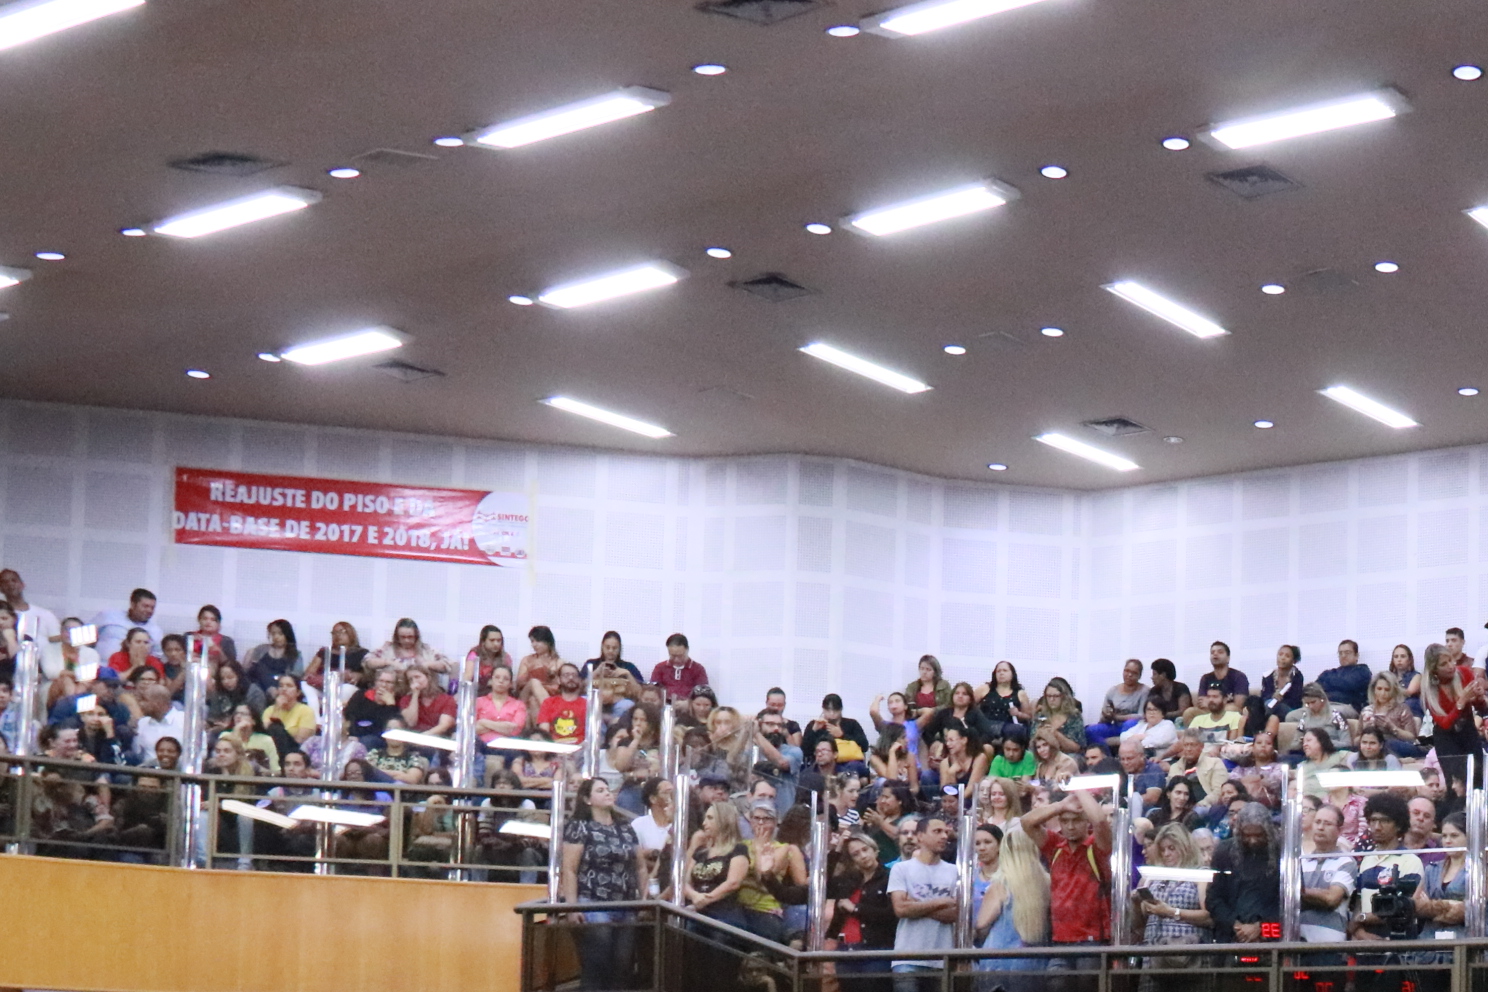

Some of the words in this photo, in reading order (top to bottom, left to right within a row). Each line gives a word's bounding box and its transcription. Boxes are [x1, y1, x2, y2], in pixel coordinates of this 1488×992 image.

[209, 481, 307, 508] REAJUSTE
[310, 490, 339, 511] DO
[342, 492, 390, 514] PISO
[173, 510, 281, 538] DATA-BASE
[284, 519, 311, 540] DE
[314, 522, 364, 543] 2017
[367, 525, 379, 545] E
[382, 526, 437, 551] 2018,
[440, 529, 471, 551] JÁ!
